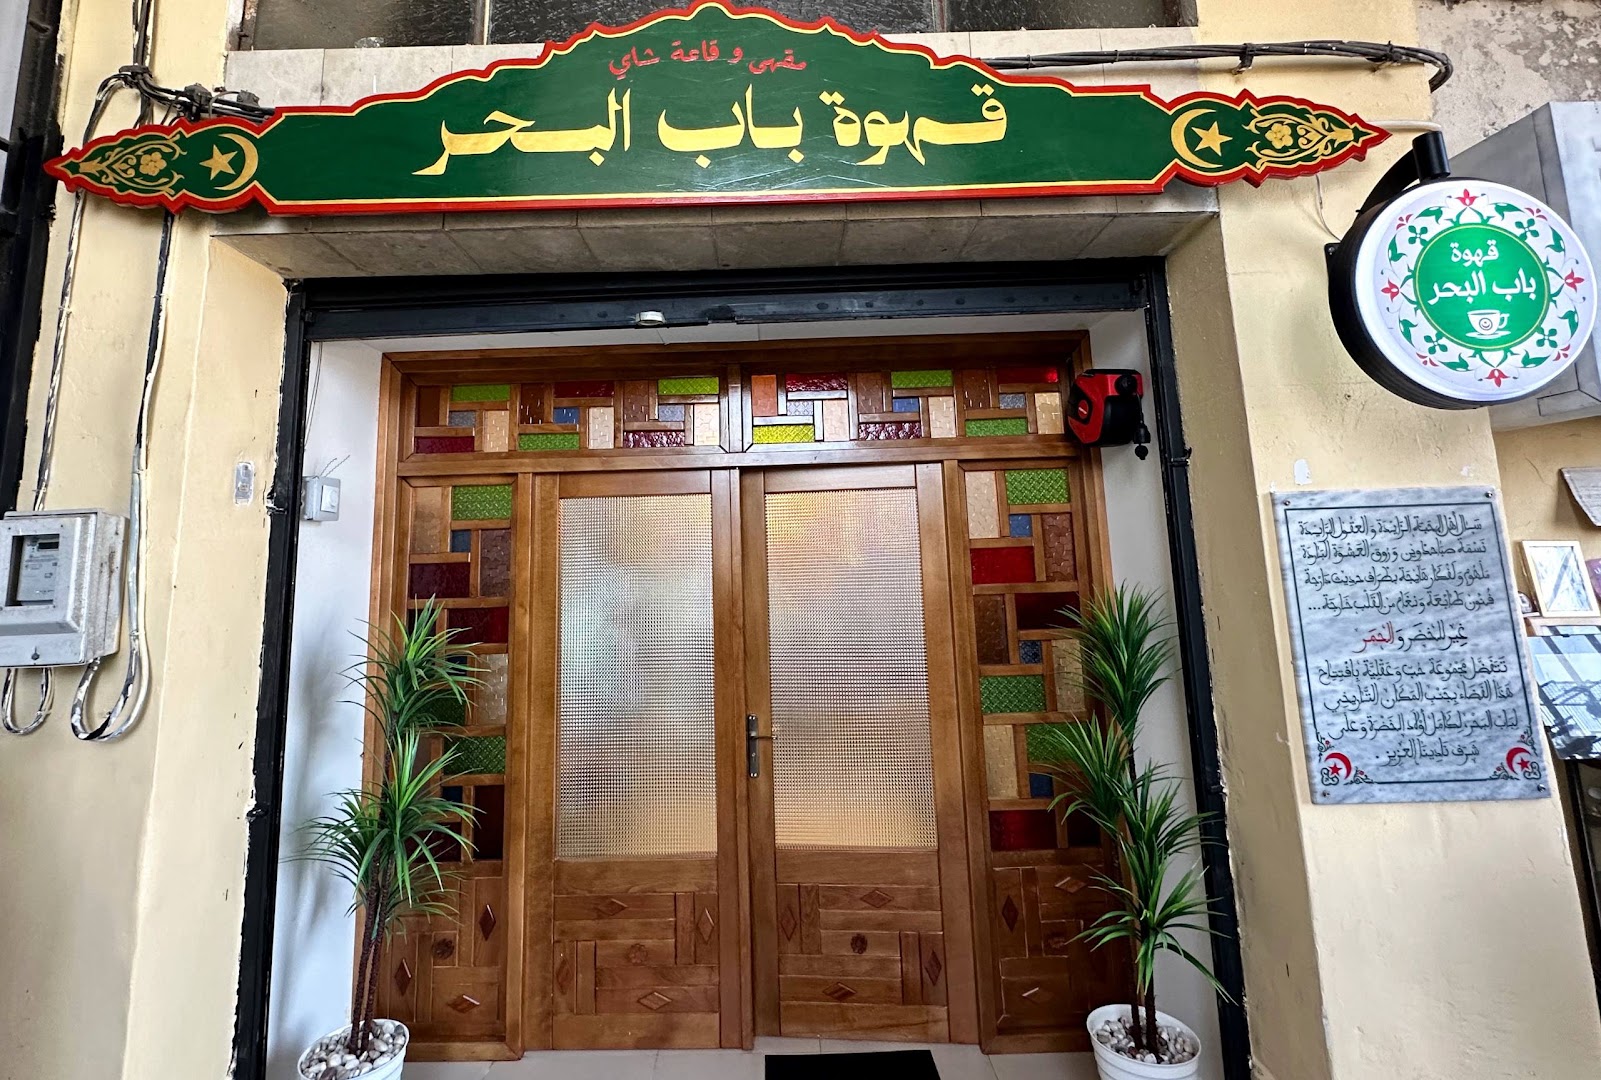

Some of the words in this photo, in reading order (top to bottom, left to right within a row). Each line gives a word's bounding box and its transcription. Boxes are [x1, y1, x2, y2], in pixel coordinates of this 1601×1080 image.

[608, 45, 661, 81] شاي
[670, 39, 720, 63] قاعة
[727, 45, 744, 64] و
[411, 87, 631, 176] البحر
[657, 84, 804, 169] باب
[817, 83, 1008, 166] قهوة
[1449, 239, 1500, 268] قهوة
[1427, 269, 1487, 305] البحر
[1491, 267, 1537, 301] باب
